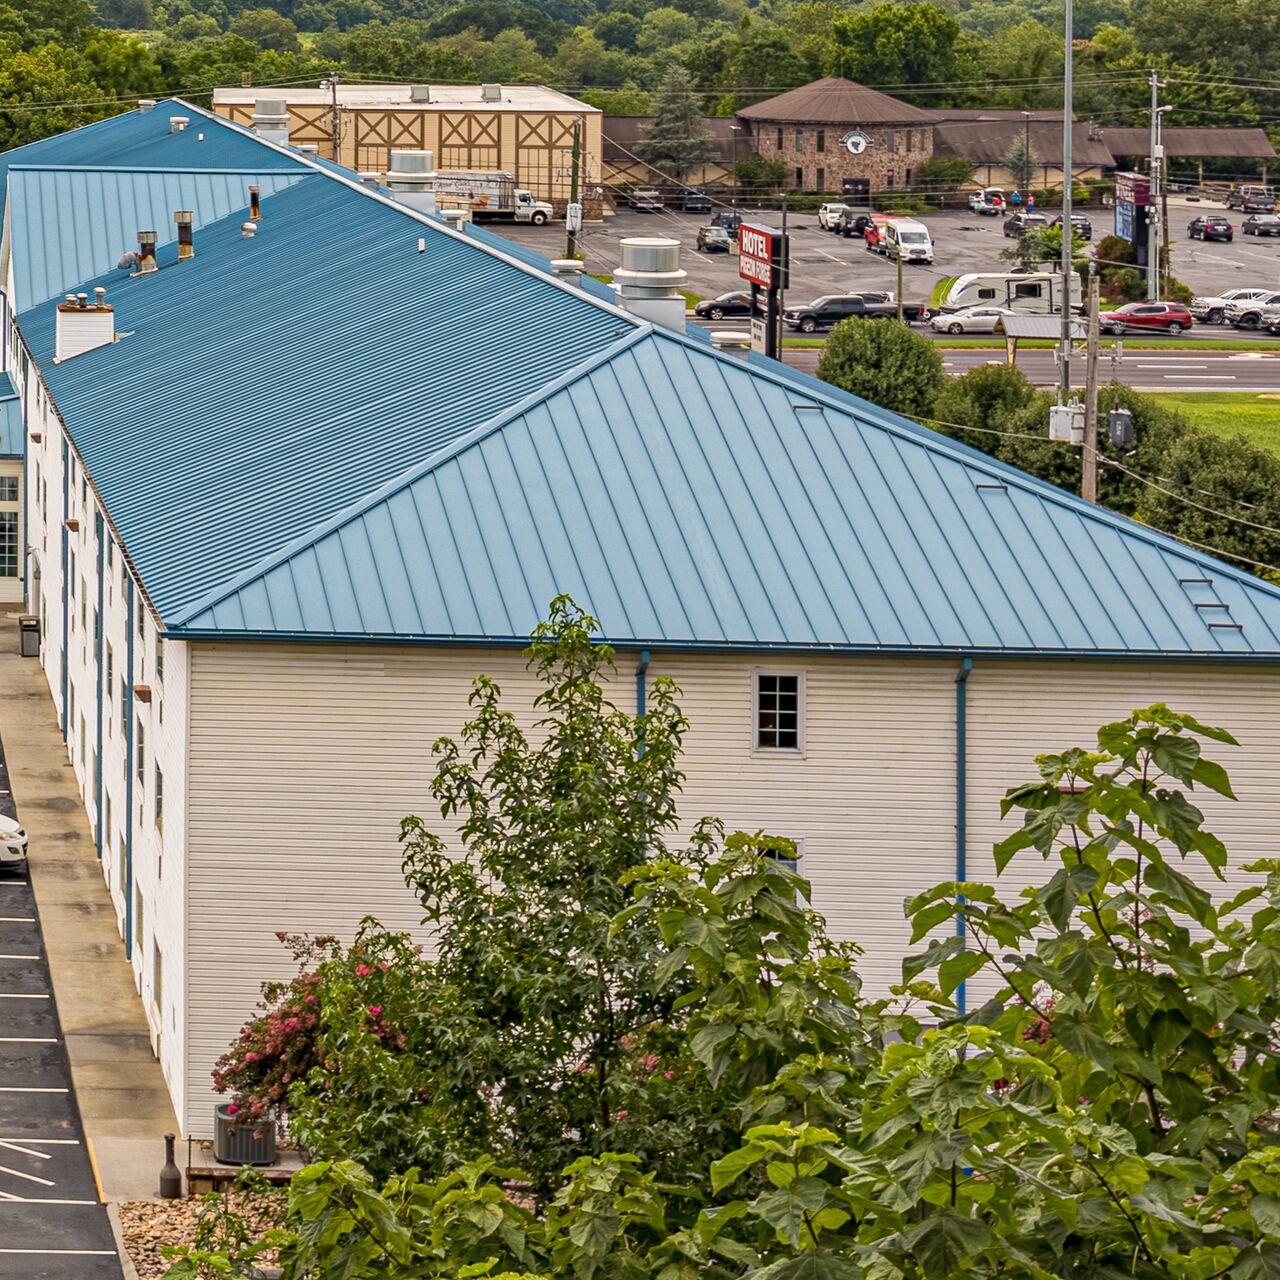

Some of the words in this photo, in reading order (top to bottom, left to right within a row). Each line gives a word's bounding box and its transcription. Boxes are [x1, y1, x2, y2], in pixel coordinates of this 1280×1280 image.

[742, 230, 768, 259] HOTEL
[740, 255, 756, 277] PIGEON
[756, 261, 771, 284] FORGE
